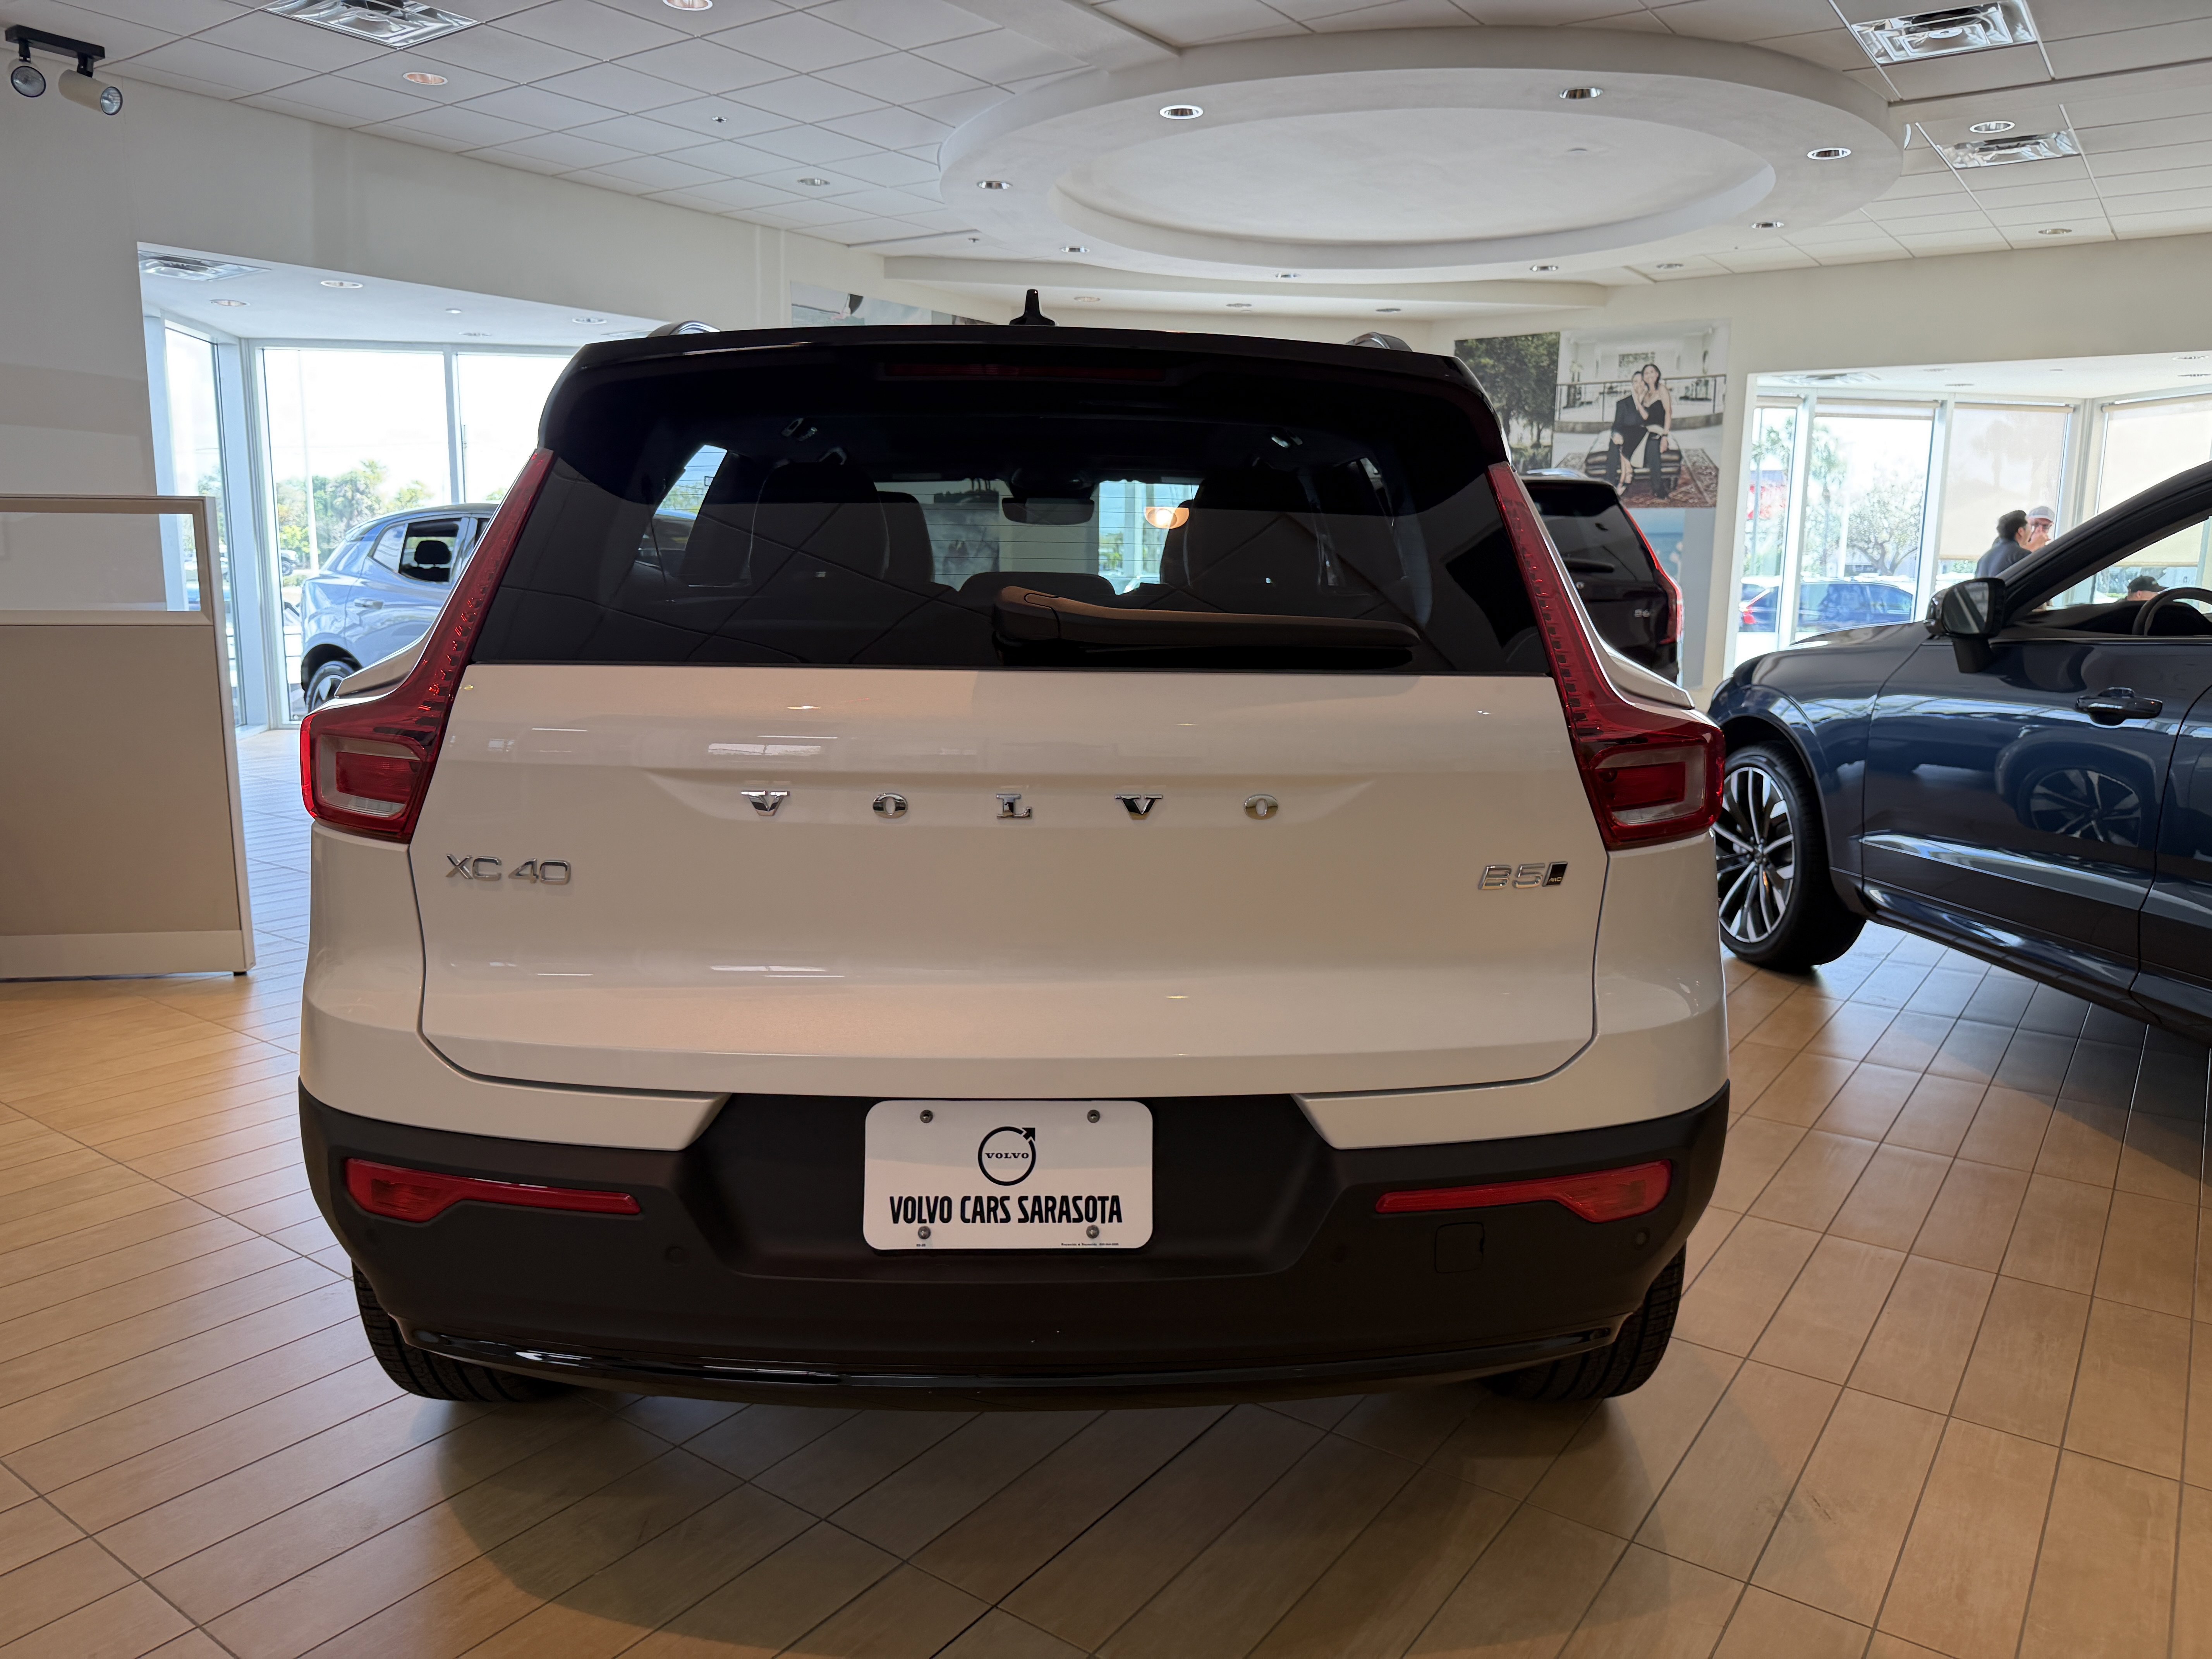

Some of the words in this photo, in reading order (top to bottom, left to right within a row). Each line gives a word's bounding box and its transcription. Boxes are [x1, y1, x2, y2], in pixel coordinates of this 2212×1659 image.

[741, 790, 1278, 820] VOLVO
[1478, 864, 1545, 890] B5
[890, 1195, 952, 1224] VOLVO
[960, 1195, 1011, 1224] CARS
[1017, 1195, 1123, 1224] SARASOTA
